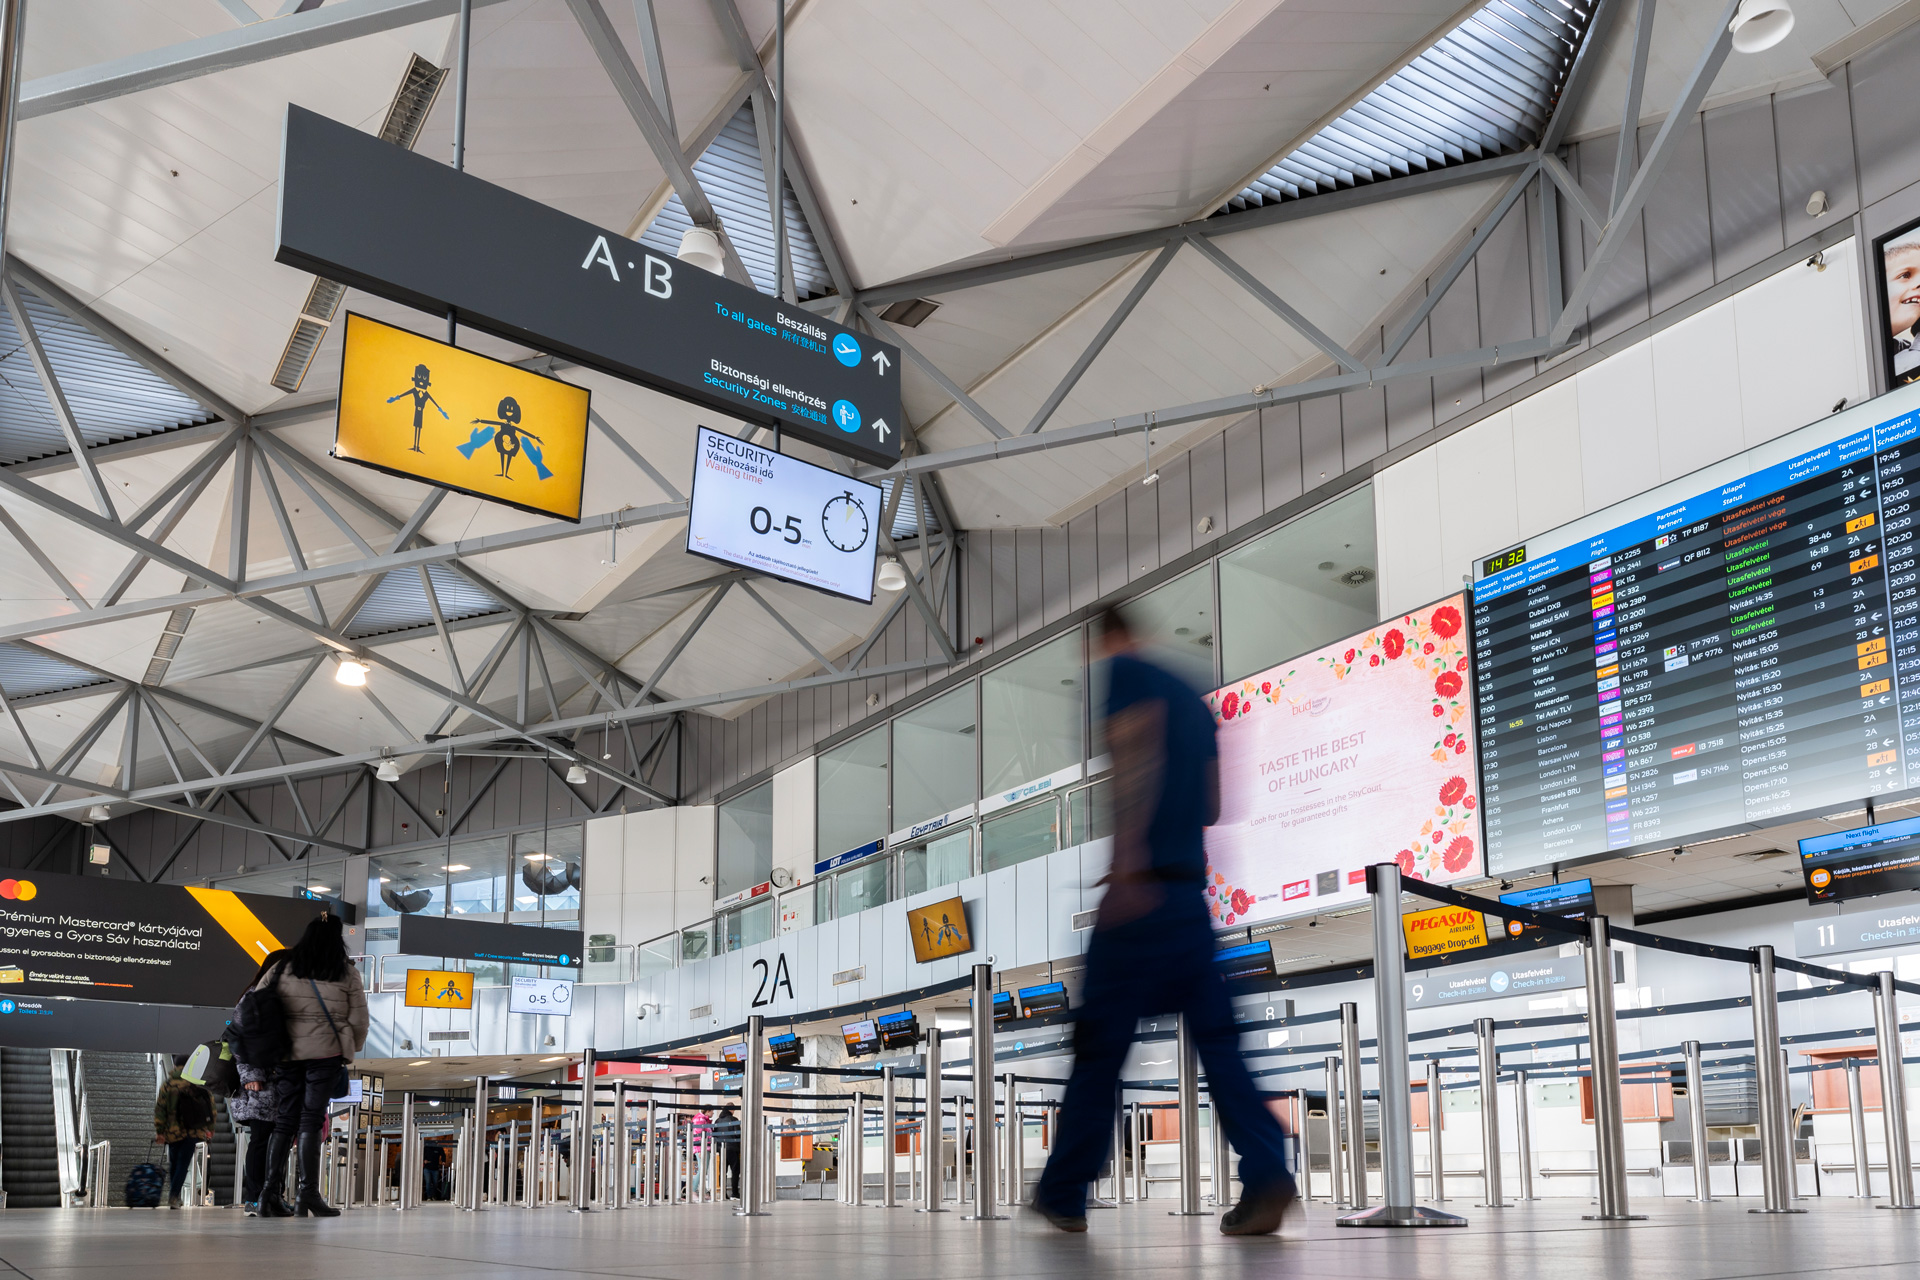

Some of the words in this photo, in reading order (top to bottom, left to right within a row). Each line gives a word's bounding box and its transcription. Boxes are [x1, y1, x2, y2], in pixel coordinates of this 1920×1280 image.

[715, 302, 728, 317] To
[732, 311, 744, 323] all
[747, 318, 777, 336] gates
[782, 330, 827, 354] 所有登机口
[777, 312, 827, 340] Beszállás
[711, 359, 770, 390] Biztonsági
[773, 382, 827, 410] ellenőrzés
[704, 372, 750, 398] Security
[753, 389, 787, 411] Zones
[791, 404, 827, 425] 安检通道
[1876, 418, 1912, 436] Tervezett
[1838, 433, 1870, 450] Terminál
[1877, 426, 1917, 447] Scheduled
[708, 436, 775, 467] SECURITY
[1839, 444, 1871, 462] Terminal
[1879, 450, 1900, 464] 19:45
[707, 449, 758, 474] Várakozási
[760, 467, 774, 479] idő
[1789, 449, 1831, 470] Utasfelvétel
[705, 458, 740, 480] Waiting
[743, 473, 763, 484] time
[1790, 465, 1820, 481] Check-in
[1842, 468, 1854, 478] 2A
[1843, 482, 1854, 491] 2B
[1882, 477, 1904, 491] 19:50
[1723, 494, 1743, 506] Status
[1883, 490, 1910, 505] 20:00
[1657, 506, 1686, 522] Partnerek
[1722, 501, 1766, 523] Utasfelvétel
[1767, 494, 1785, 506] vége
[1885, 504, 1910, 519] 20:20
[750, 506, 802, 545] 0-5
[1658, 517, 1683, 531] Partners
[1682, 529, 1692, 538] TP
[1693, 522, 1709, 534] 8187
[1809, 531, 1832, 545] 38-46
[1508, 549, 1524, 566] 32
[1591, 547, 1607, 557] Flight
[1614, 555, 1624, 563] LX
[1625, 548, 1641, 559] 2255
[1726, 540, 1769, 561] Utasfelvétel
[1810, 546, 1829, 558] 16-18
[1888, 546, 1913, 560] 20:25
[1529, 566, 1560, 581] Destination
[1811, 562, 1822, 571] 69
[1890, 560, 1915, 573] 20:30
[1728, 565, 1771, 585] Utasfelvétel
[1476, 581, 1498, 592] Tervezett
[1503, 578, 1527, 591] Expected
[1528, 584, 1546, 596] Zurich
[1476, 587, 1502, 602] Scheduled
[1528, 595, 1549, 607] Athens
[1756, 592, 1773, 603] 14:35
[1529, 606, 1546, 618] Dubai
[1547, 601, 1561, 612] DXB
[1619, 614, 1629, 623] LO
[1630, 608, 1646, 619] 2001
[1894, 601, 1918, 615] 20:55
[1530, 616, 1553, 630] Istanbul
[1554, 610, 1570, 621] SAW
[1895, 617, 1917, 629] 21:05
[1531, 629, 1552, 641] Malaga
[1759, 630, 1778, 642] 15:05
[1534, 686, 1556, 698] Munich
[1292, 699, 1312, 716] bud
[1259, 752, 1299, 777] TASTE
[1302, 743, 1328, 762] THE
[1332, 730, 1366, 753] BEST
[1268, 777, 1286, 792] OF
[1289, 754, 1358, 787] HUNGARY
[1251, 817, 1266, 827] Look
[1268, 813, 1277, 822] for
[1278, 811, 1289, 819] our
[1291, 800, 1325, 816] hostesses
[1335, 794, 1346, 803] the
[1348, 784, 1382, 799] SkyCourt
[1282, 821, 1290, 829] for
[1292, 810, 1330, 827] guaranteed
[1332, 805, 1348, 816] gifts
[911, 819, 943, 838] EGYPTAIR
[1862, 829, 1879, 837] flight
[830, 856, 842, 868] LOT
[1852, 870, 1871, 878] prepare
[1411, 910, 1476, 932] PEGASUS
[139, 922, 202, 938] kártyájával
[1449, 924, 1475, 934] AIRLINES
[1818, 924, 1835, 947] 11
[1861, 929, 1906, 942] Check-in
[55, 931, 63, 939] a
[67, 930, 103, 943] Gyors
[107, 934, 130, 945] Sáv
[133, 935, 200, 950] használata!
[1414, 943, 1446, 954] Baggage
[1448, 935, 1480, 949] Drop-off
[31, 950, 76, 958] gyorsabban
[84, 953, 122, 963] biztonsági
[123, 956, 172, 966] ellenőrzéshez!
[752, 953, 794, 1008] 2A
[1512, 968, 1553, 980] Utasfelvétel
[1450, 977, 1487, 989] Utasfelvétel
[1513, 979, 1544, 989] Check-in
[529, 995, 546, 1004] 0-5
[1412, 985, 1424, 1002] 9
[1438, 989, 1466, 999] Check-in
[1266, 1006, 1275, 1021] 8
[794, 1075, 799, 1086] 2
